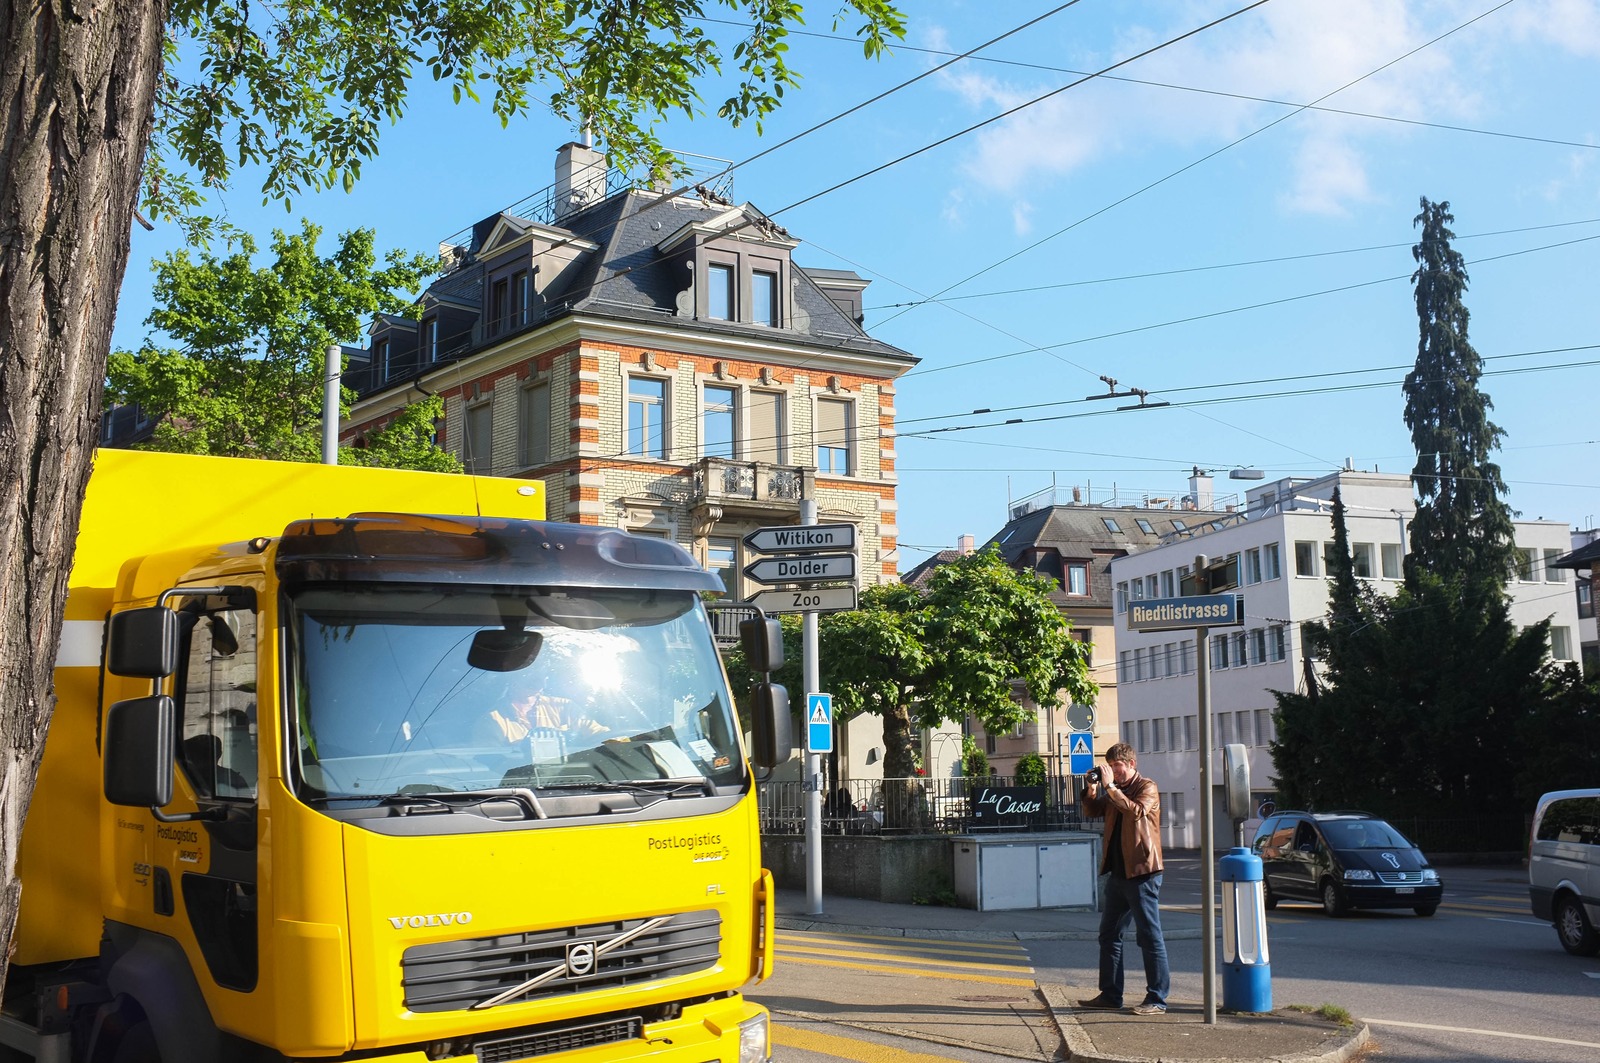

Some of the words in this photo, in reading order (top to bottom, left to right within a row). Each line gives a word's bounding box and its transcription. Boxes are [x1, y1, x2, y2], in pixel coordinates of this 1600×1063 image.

[775, 531, 833, 546] Witikon
[778, 561, 829, 576] Dolder
[793, 593, 821, 607] Zoo
[1133, 603, 1228, 622] Riedtlistrasse
[978, 788, 998, 804] La
[157, 824, 198, 845] PostLogistics
[648, 832, 722, 850] PostLogistics
[705, 883, 727, 897] FL
[388, 911, 473, 929] VOLVO
